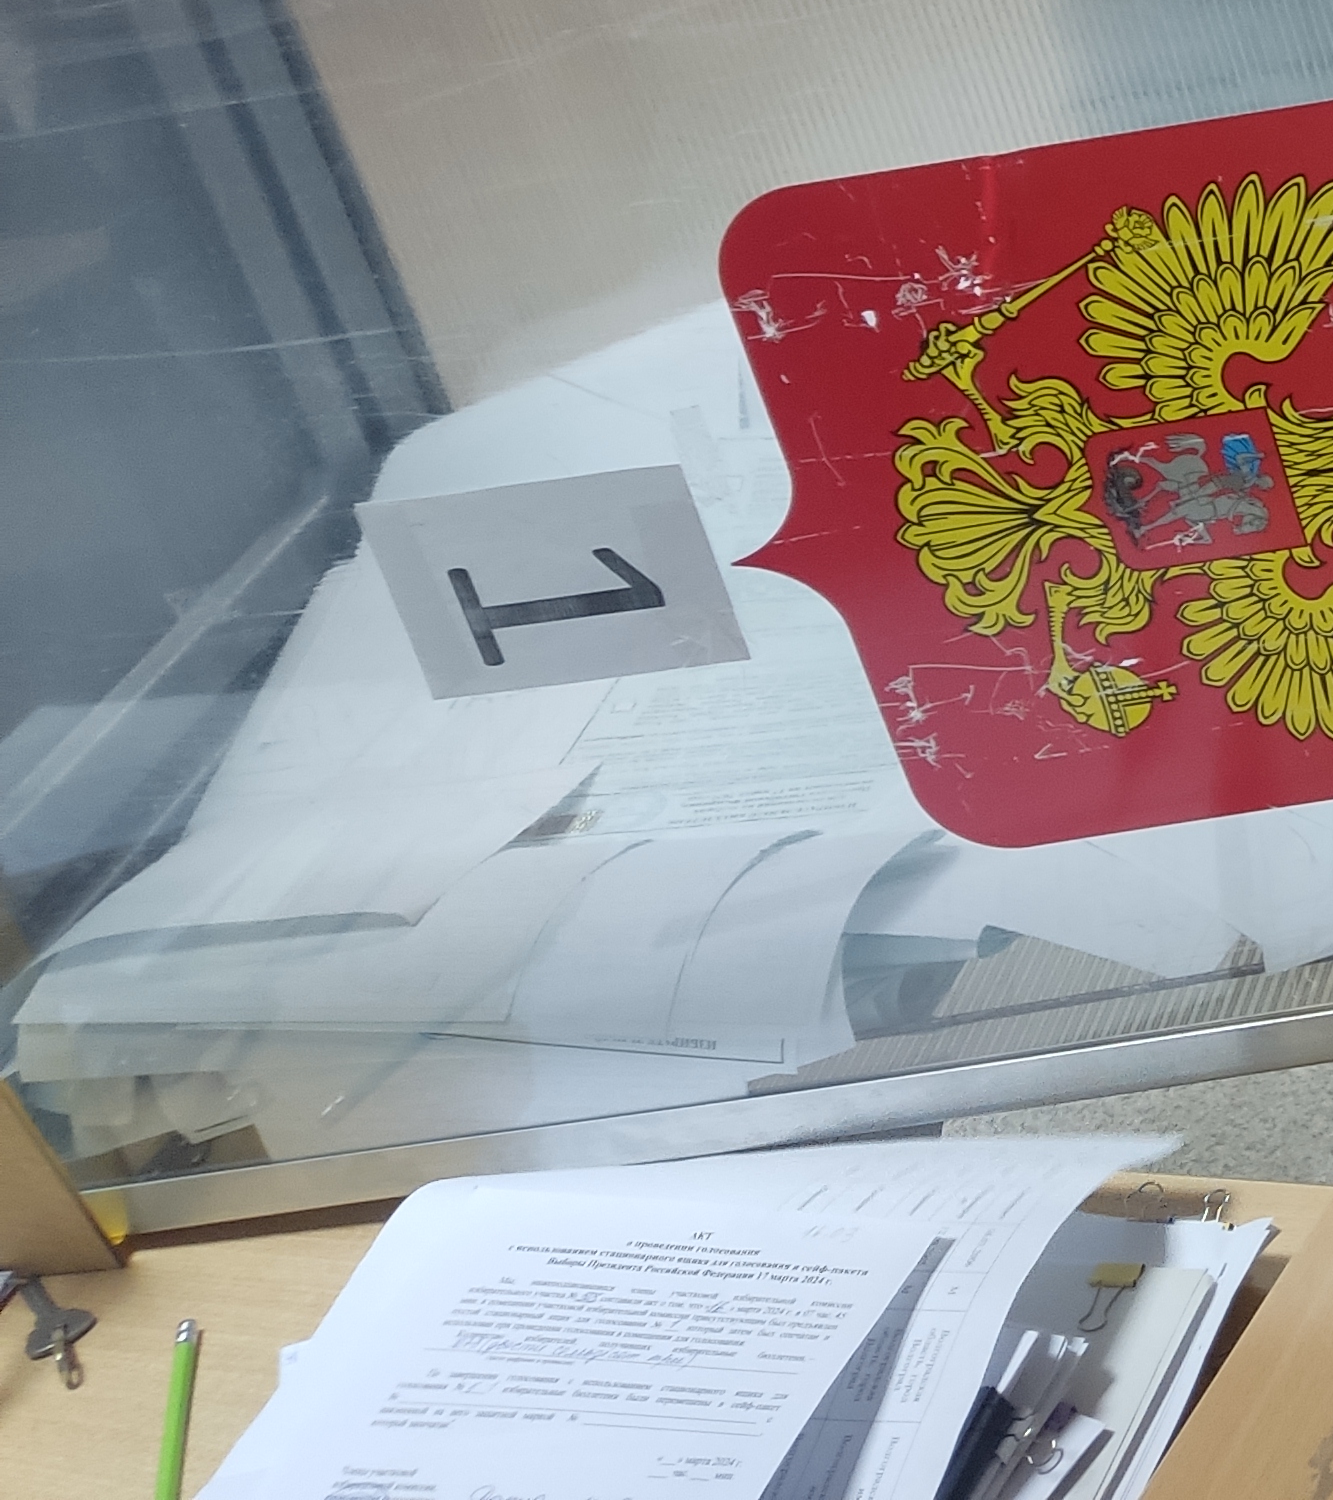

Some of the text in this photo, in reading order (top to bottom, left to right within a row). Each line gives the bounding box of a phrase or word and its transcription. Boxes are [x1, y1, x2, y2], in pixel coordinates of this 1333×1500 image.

[447, 546, 667, 667] 1
[690, 1231, 715, 1241] АКТ
[770, 1273, 800, 1285] марта
[801, 1275, 824, 1286] 2024
